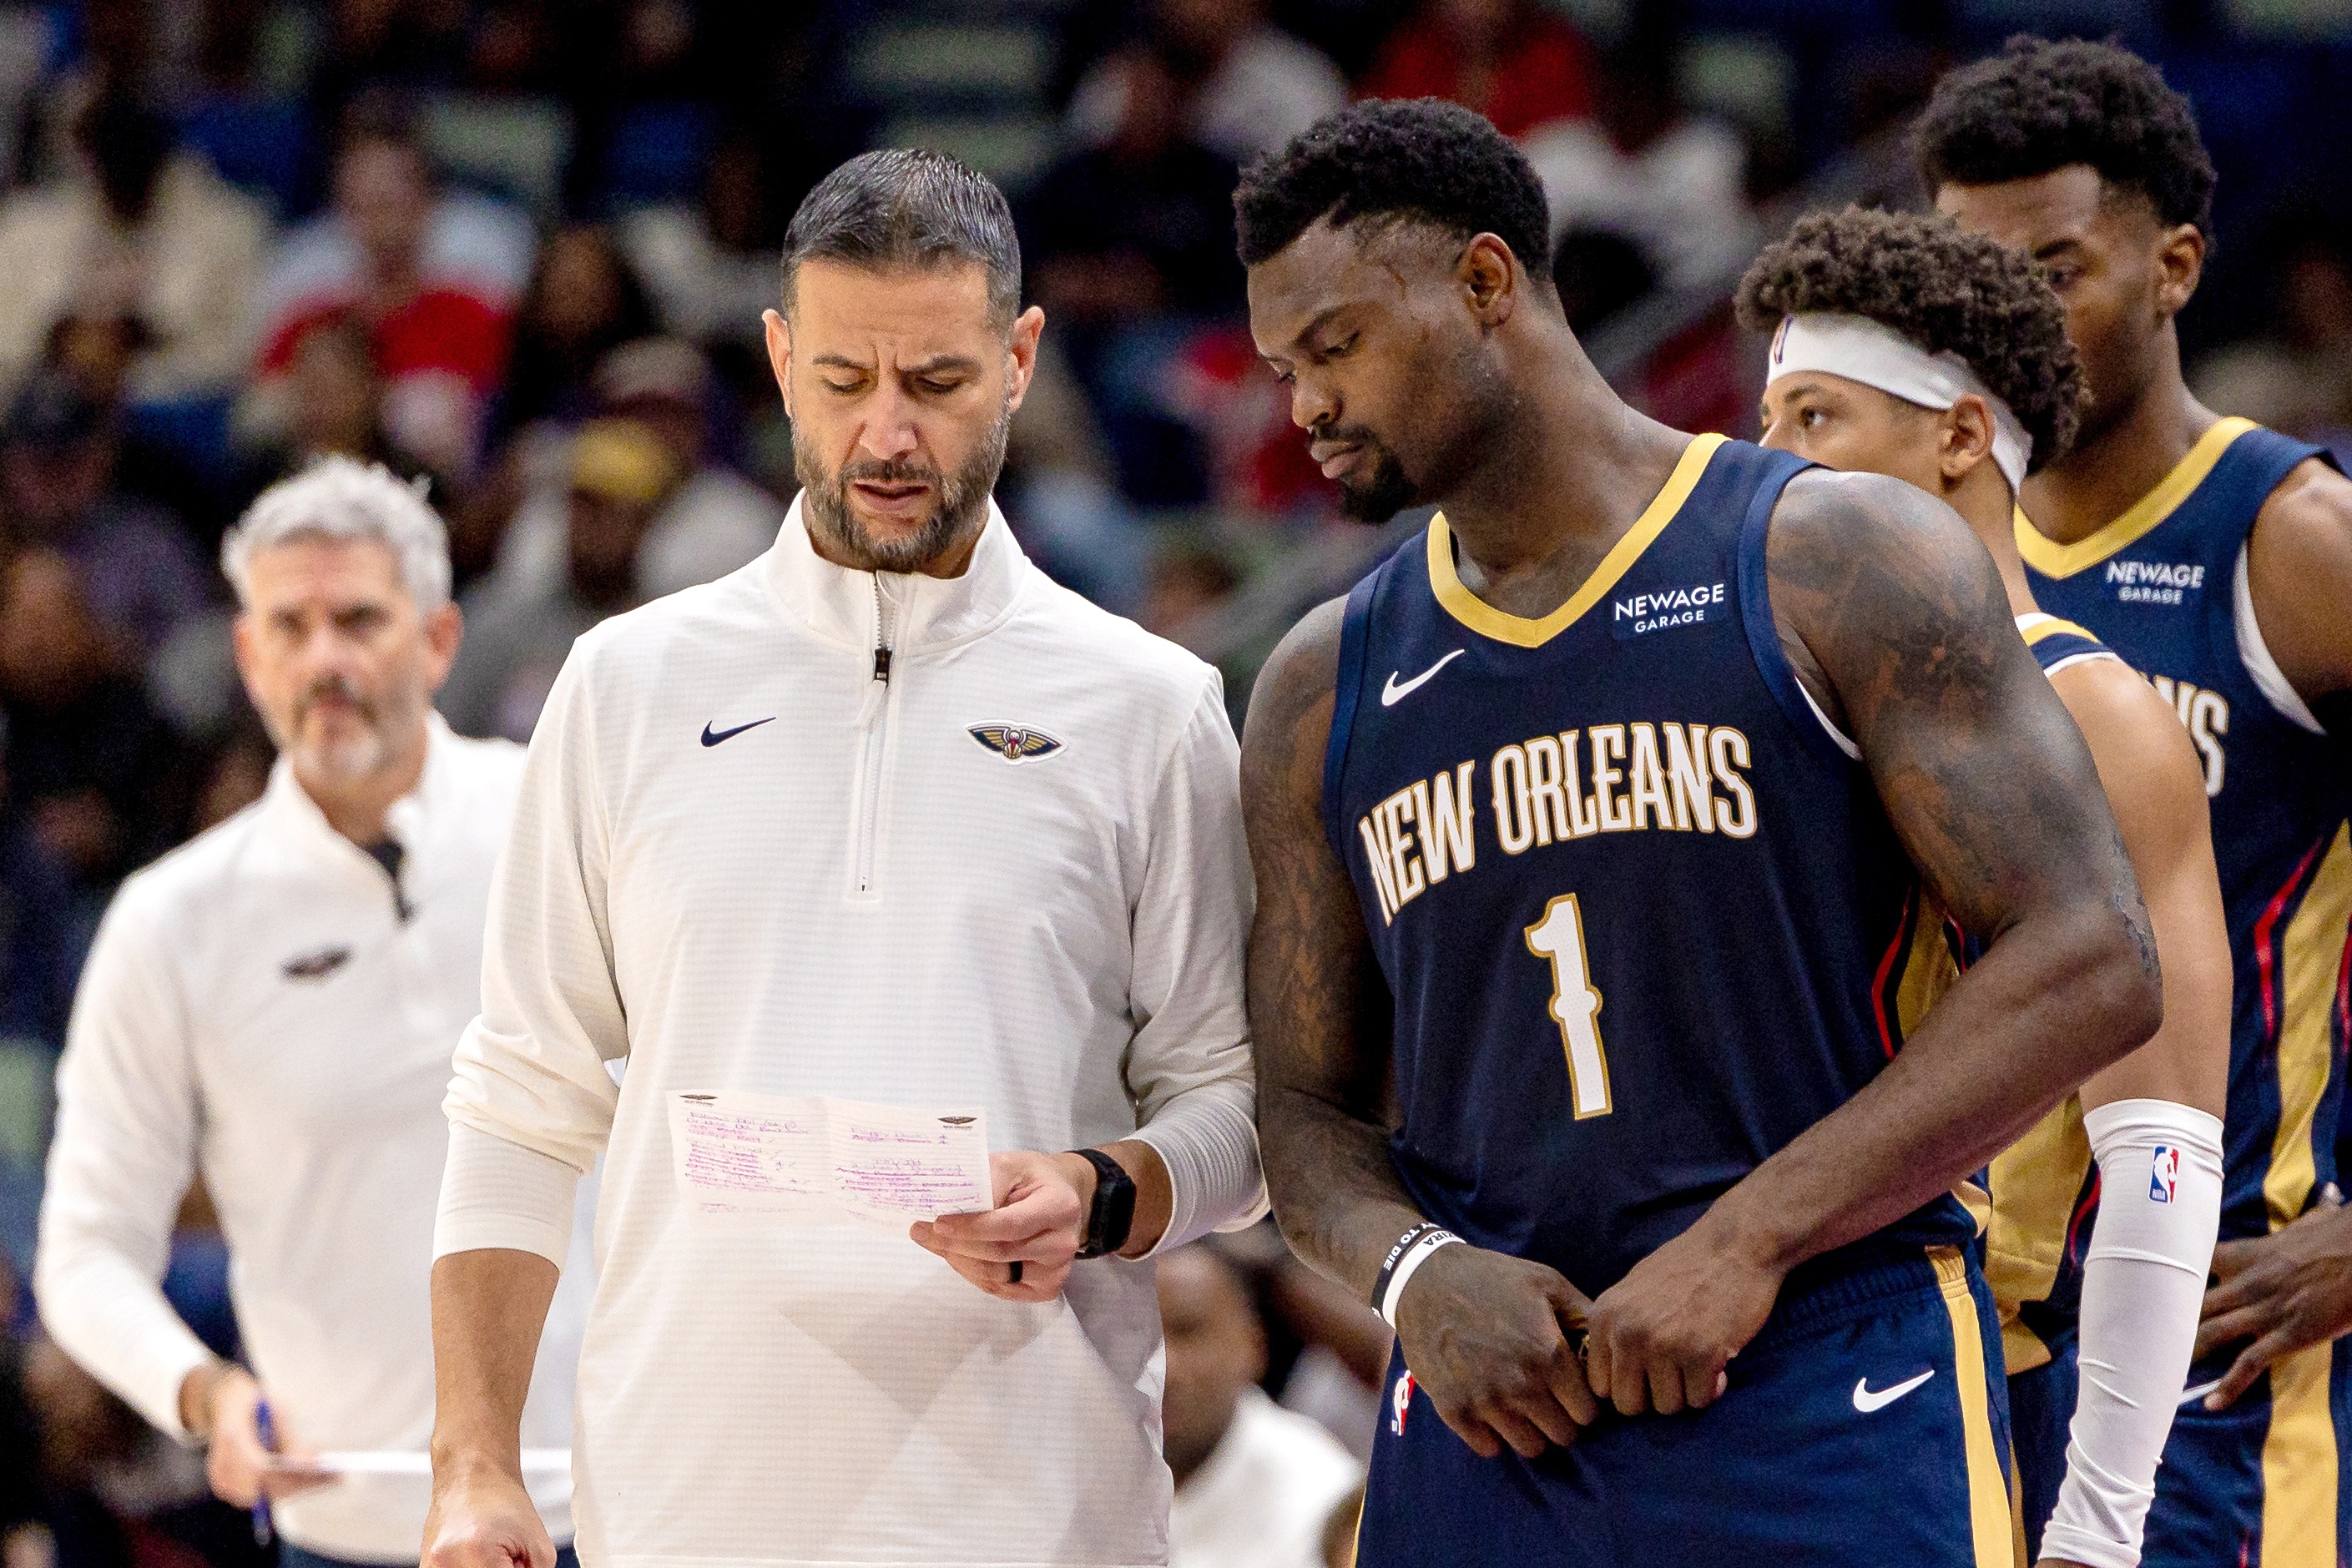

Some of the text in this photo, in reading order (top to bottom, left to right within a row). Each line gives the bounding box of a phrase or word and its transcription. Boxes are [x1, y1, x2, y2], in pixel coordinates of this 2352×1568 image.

[2106, 561, 2205, 588] NEWAGE
[1614, 583, 1724, 621] NEWAGE
[2118, 586, 2183, 605] GARAGE
[1635, 609, 1704, 633] GARAGE
[1358, 722, 1758, 926] NEW ORLEANS
[1524, 892, 1613, 1121] 1
[1383, 1228, 1421, 1271] TO DIE
